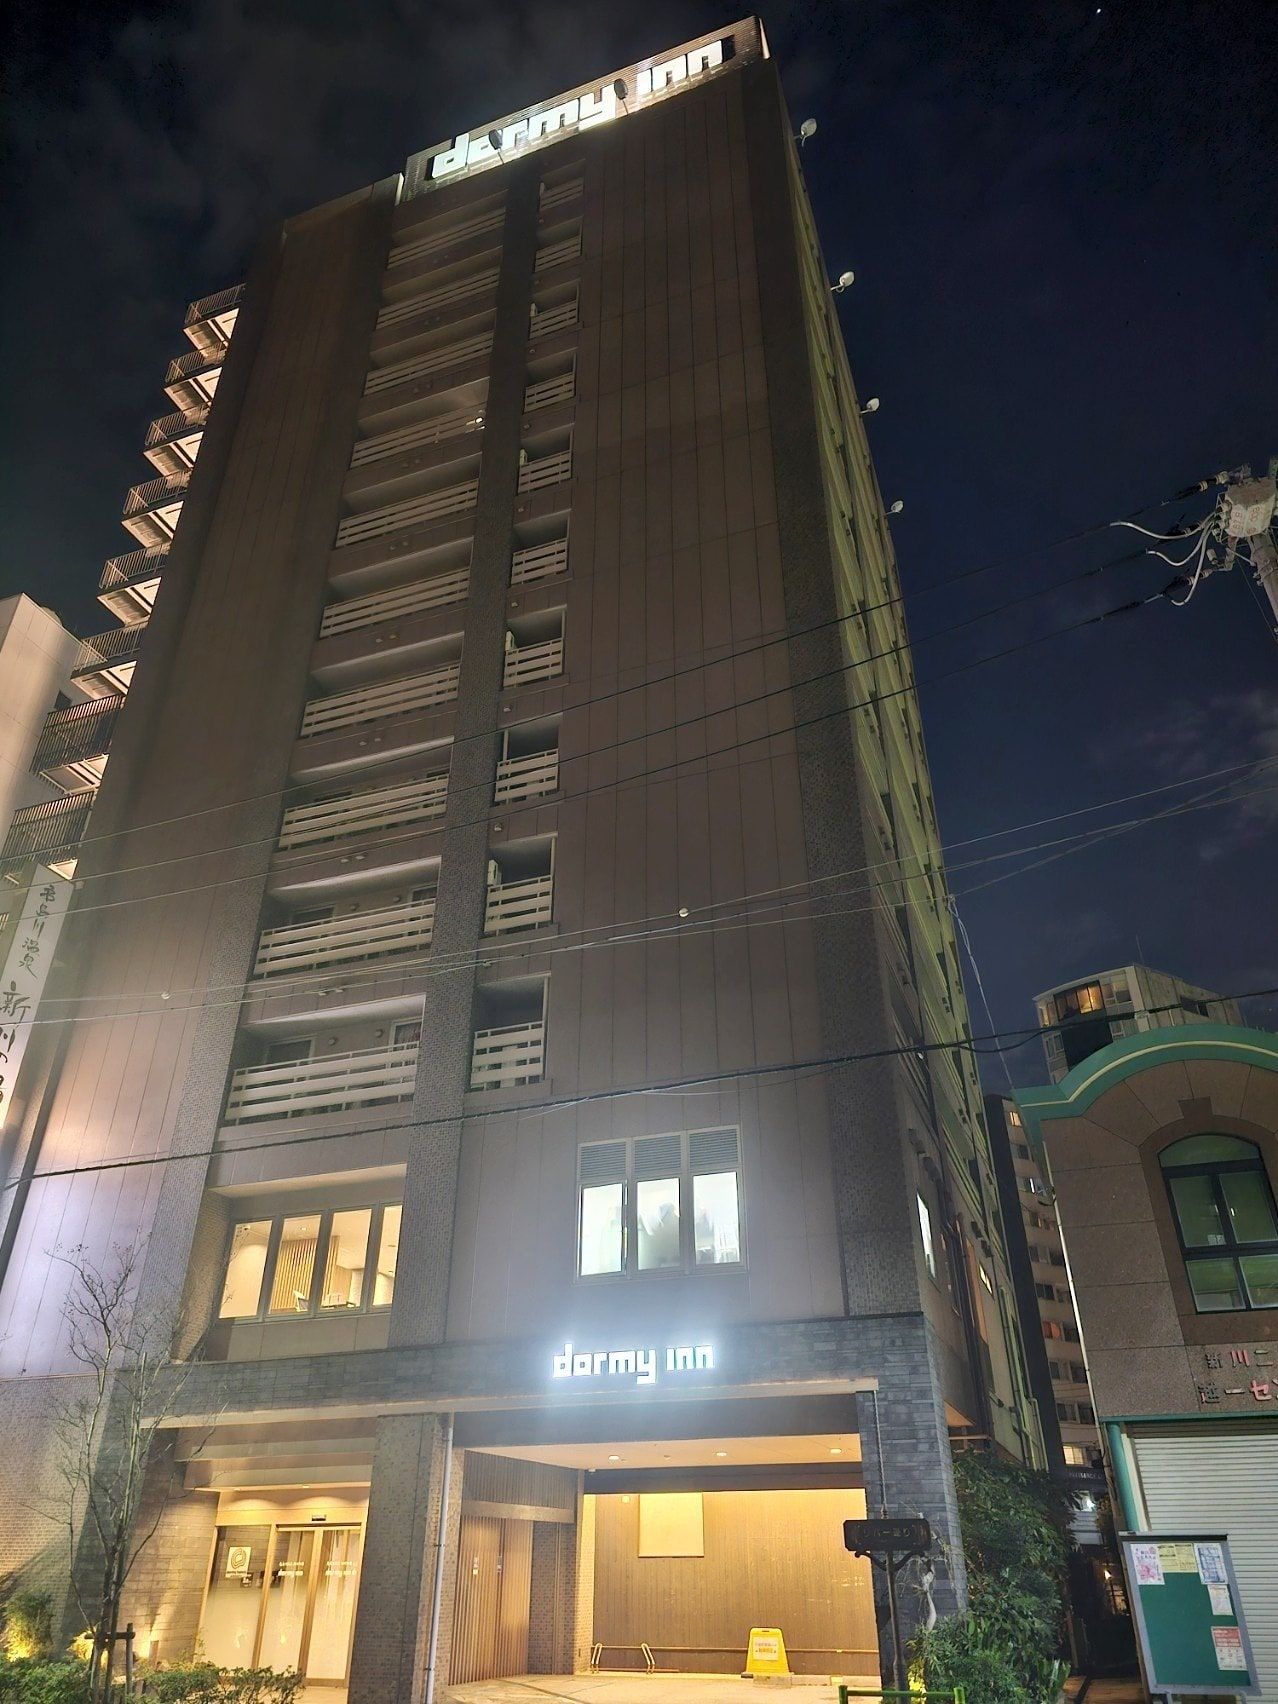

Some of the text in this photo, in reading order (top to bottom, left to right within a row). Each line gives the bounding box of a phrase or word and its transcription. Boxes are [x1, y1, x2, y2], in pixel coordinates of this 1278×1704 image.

[431, 40, 723, 180] dormy inn
[553, 1343, 714, 1385] dormy inn
